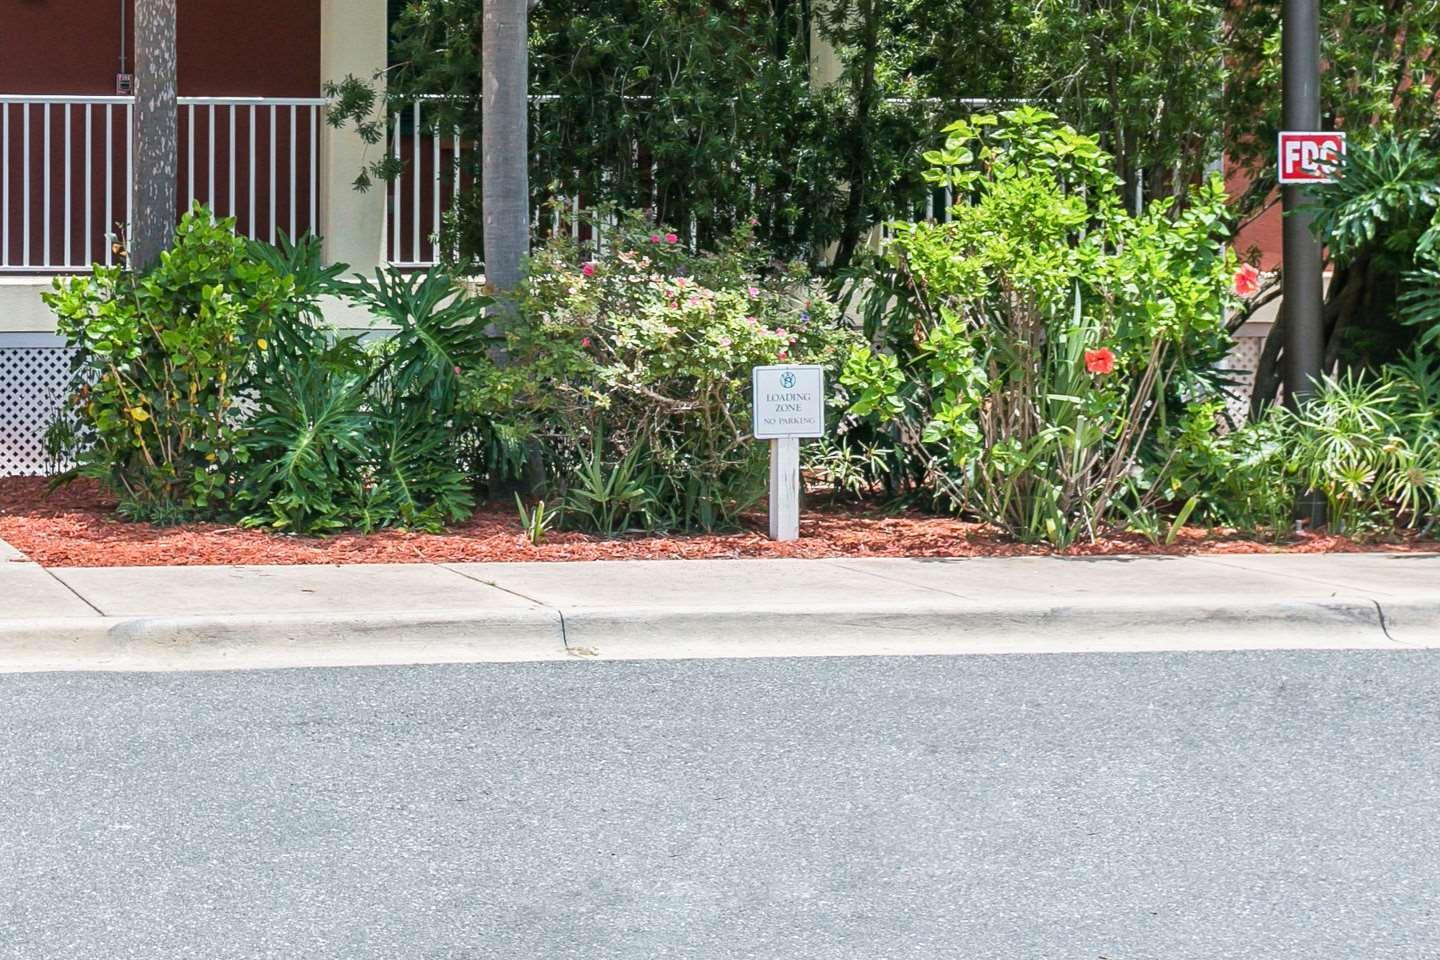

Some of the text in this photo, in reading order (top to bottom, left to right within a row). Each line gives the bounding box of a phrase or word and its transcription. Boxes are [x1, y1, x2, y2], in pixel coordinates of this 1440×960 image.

[766, 392, 811, 402] LOADING
[775, 403, 803, 413] ZONE
[764, 416, 816, 425] NO PARKING
